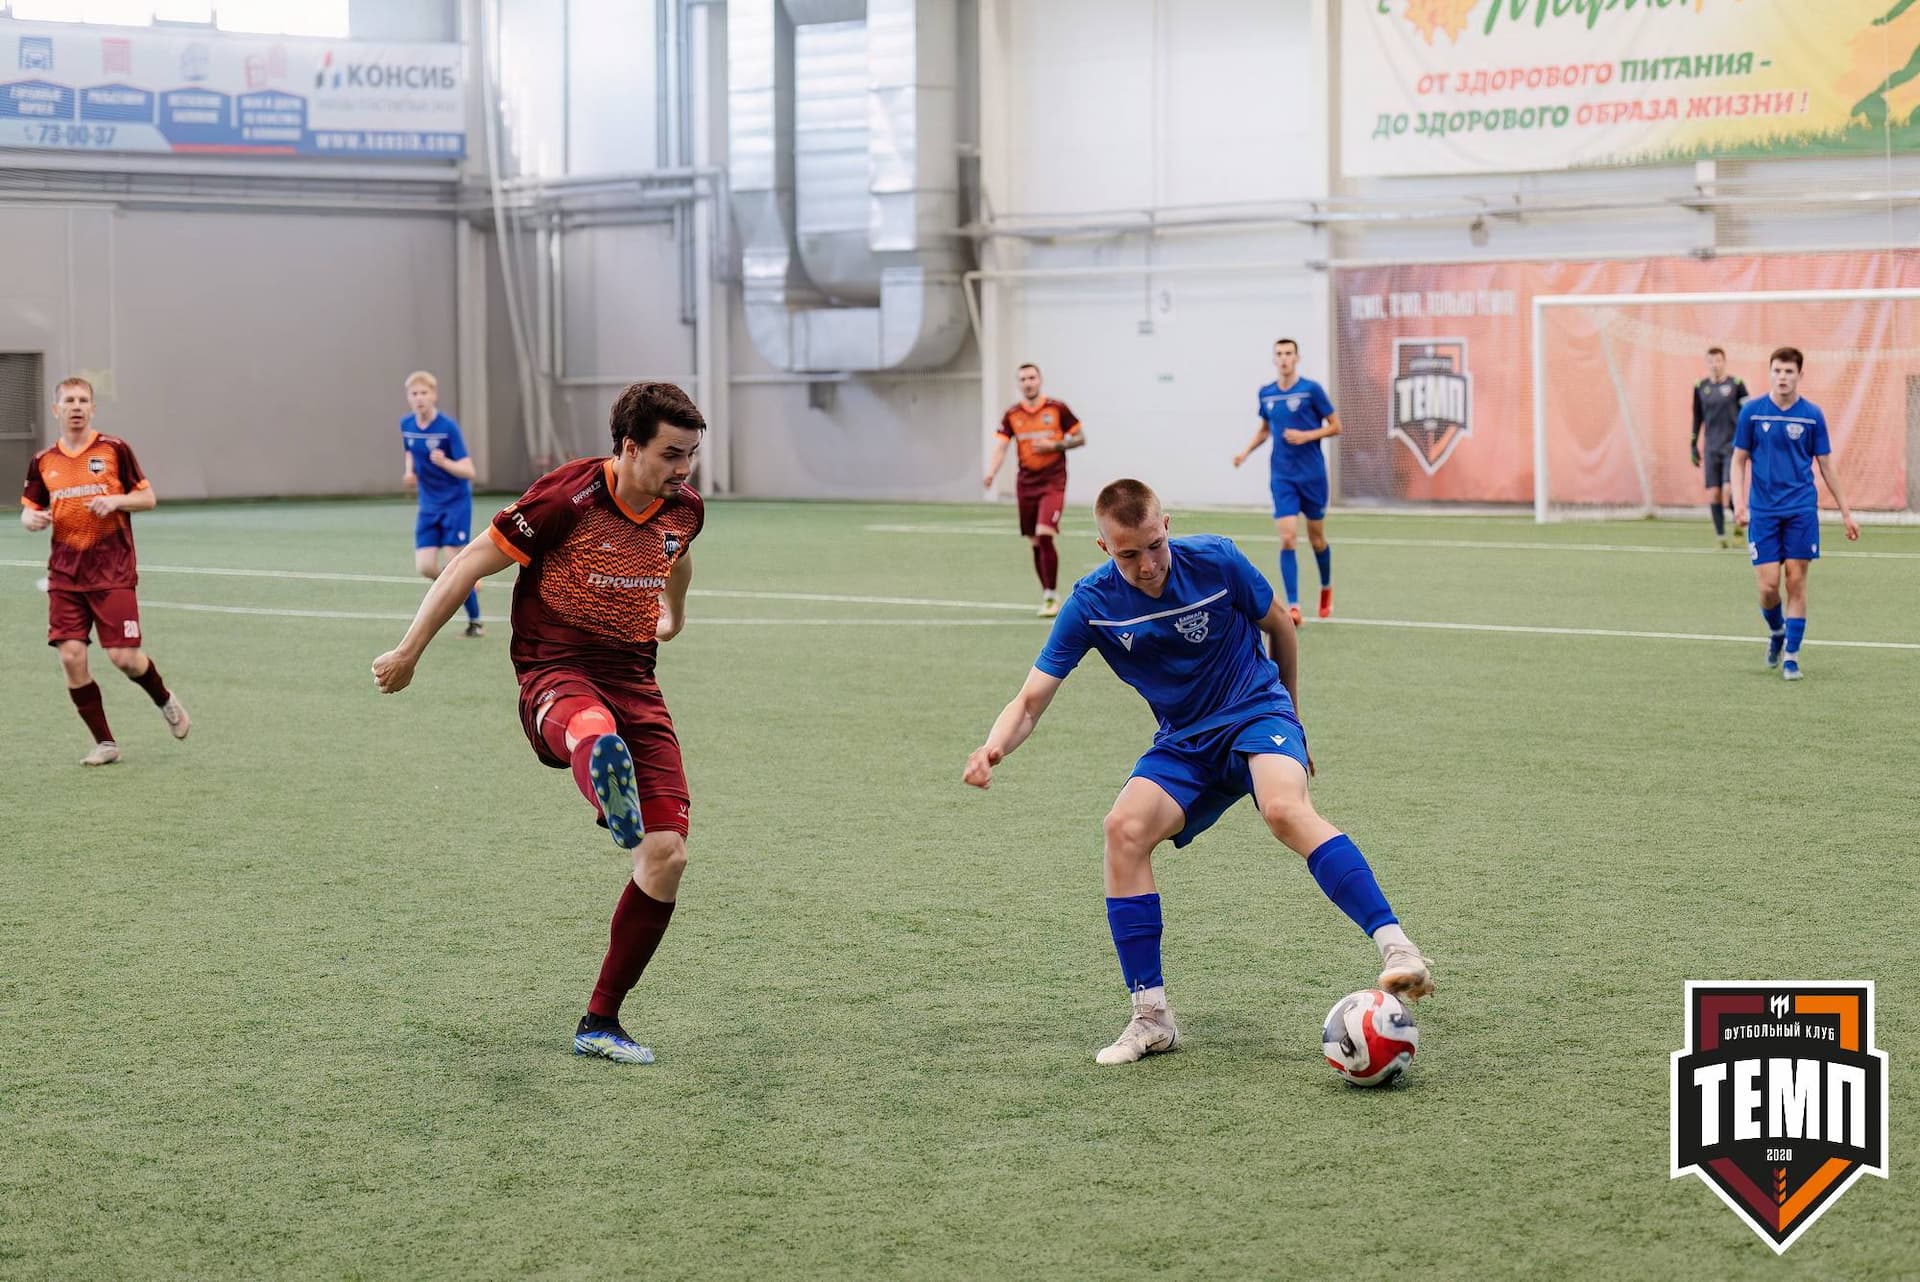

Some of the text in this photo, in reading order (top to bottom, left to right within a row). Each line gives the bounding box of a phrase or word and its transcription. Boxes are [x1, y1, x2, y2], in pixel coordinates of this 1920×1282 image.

[348, 64, 456, 89] КОНСИБ
[1416, 73, 1450, 95] ОТ
[1455, 63, 1613, 95] ЗДОРОВОГО
[1621, 52, 1754, 83] ПИТАНИЯ
[1372, 112, 1409, 139] ДО
[1414, 104, 1570, 138] ЗДОРОВОГО
[1576, 97, 1679, 126] ОБРАЗА
[1686, 91, 1794, 120] ЖИЗНИ
[1396, 375, 1466, 424] ТЕМП
[512, 512, 535, 538] ПСБ
[123, 620, 139, 638] 20
